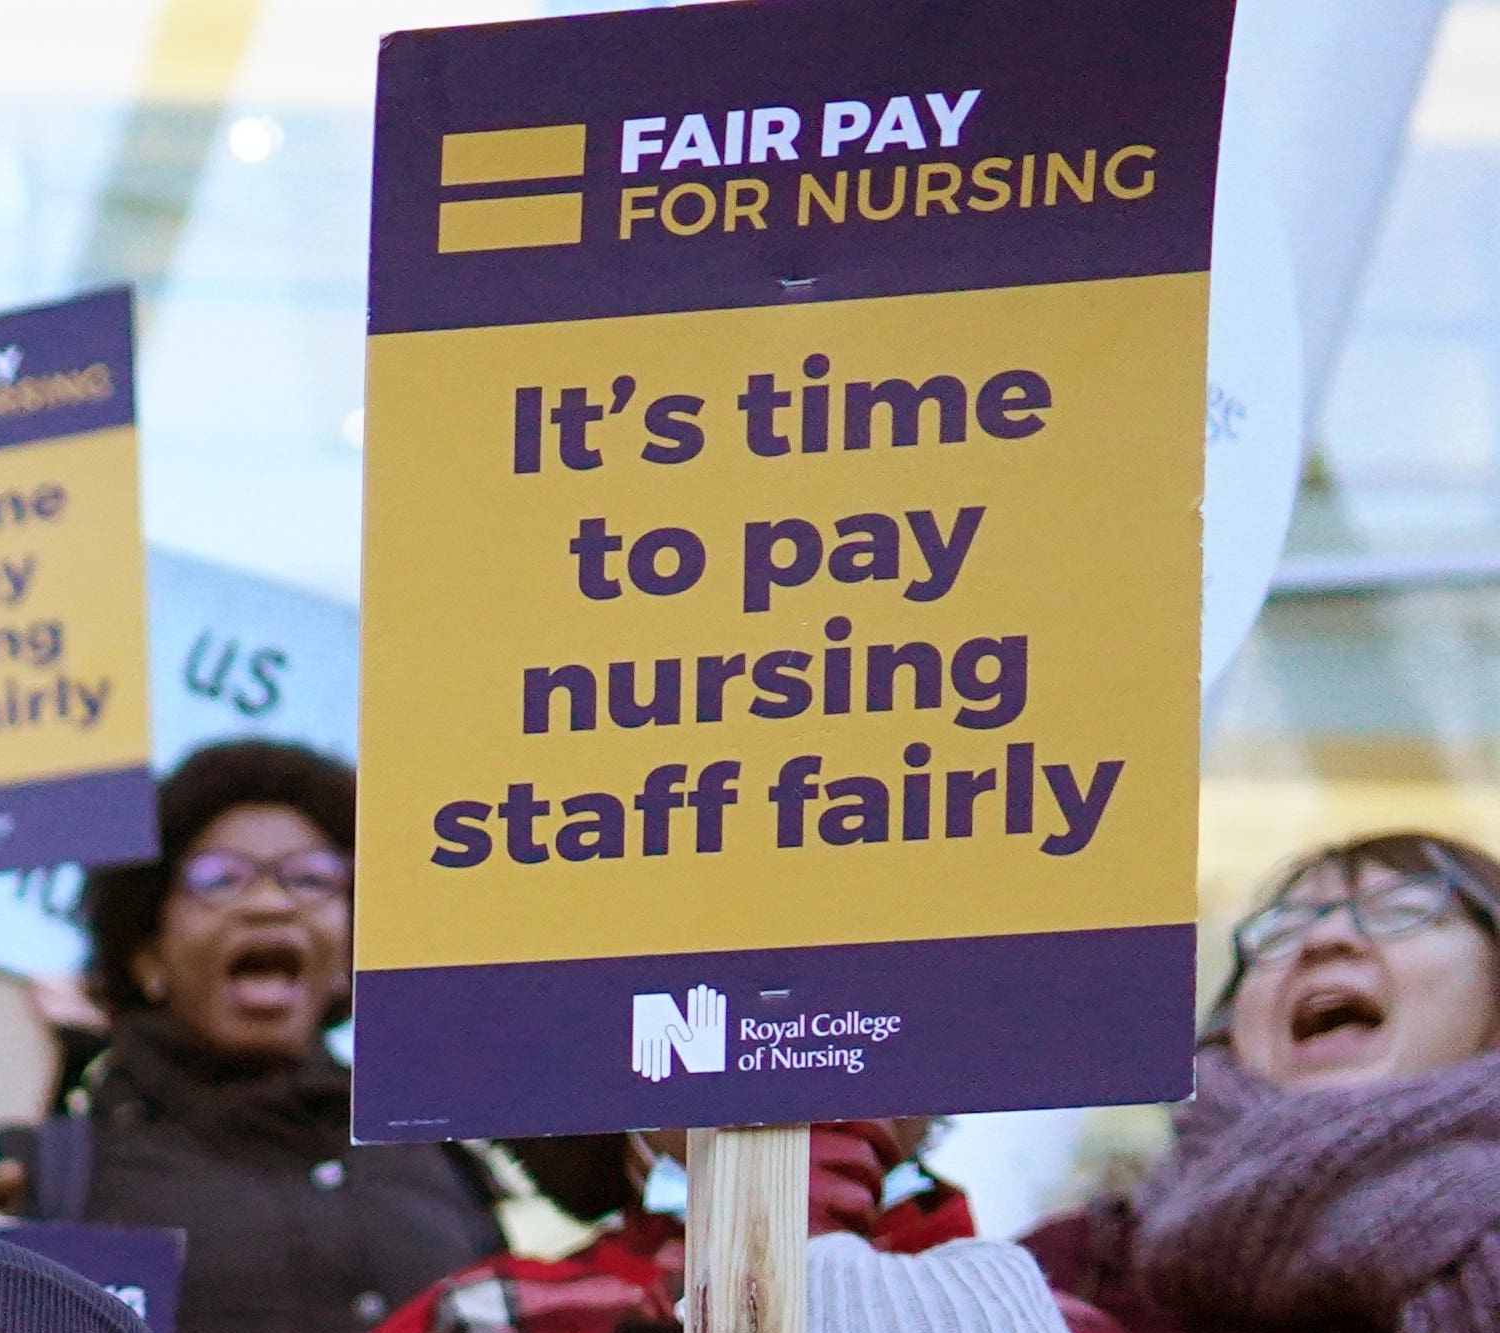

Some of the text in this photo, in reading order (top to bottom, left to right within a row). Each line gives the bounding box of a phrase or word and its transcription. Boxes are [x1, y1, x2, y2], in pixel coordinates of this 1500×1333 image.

[621, 88, 981, 173] FAIR PAY
[618, 144, 1158, 241] FOR NURSING
[512, 353, 1053, 474] It's time
[570, 505, 986, 613] to pay
[522, 617, 1030, 735] nursing
[430, 742, 1125, 869] staff fairly
[738, 1045, 864, 1073] of Nursing
[740, 1011, 900, 1047] Royal College
